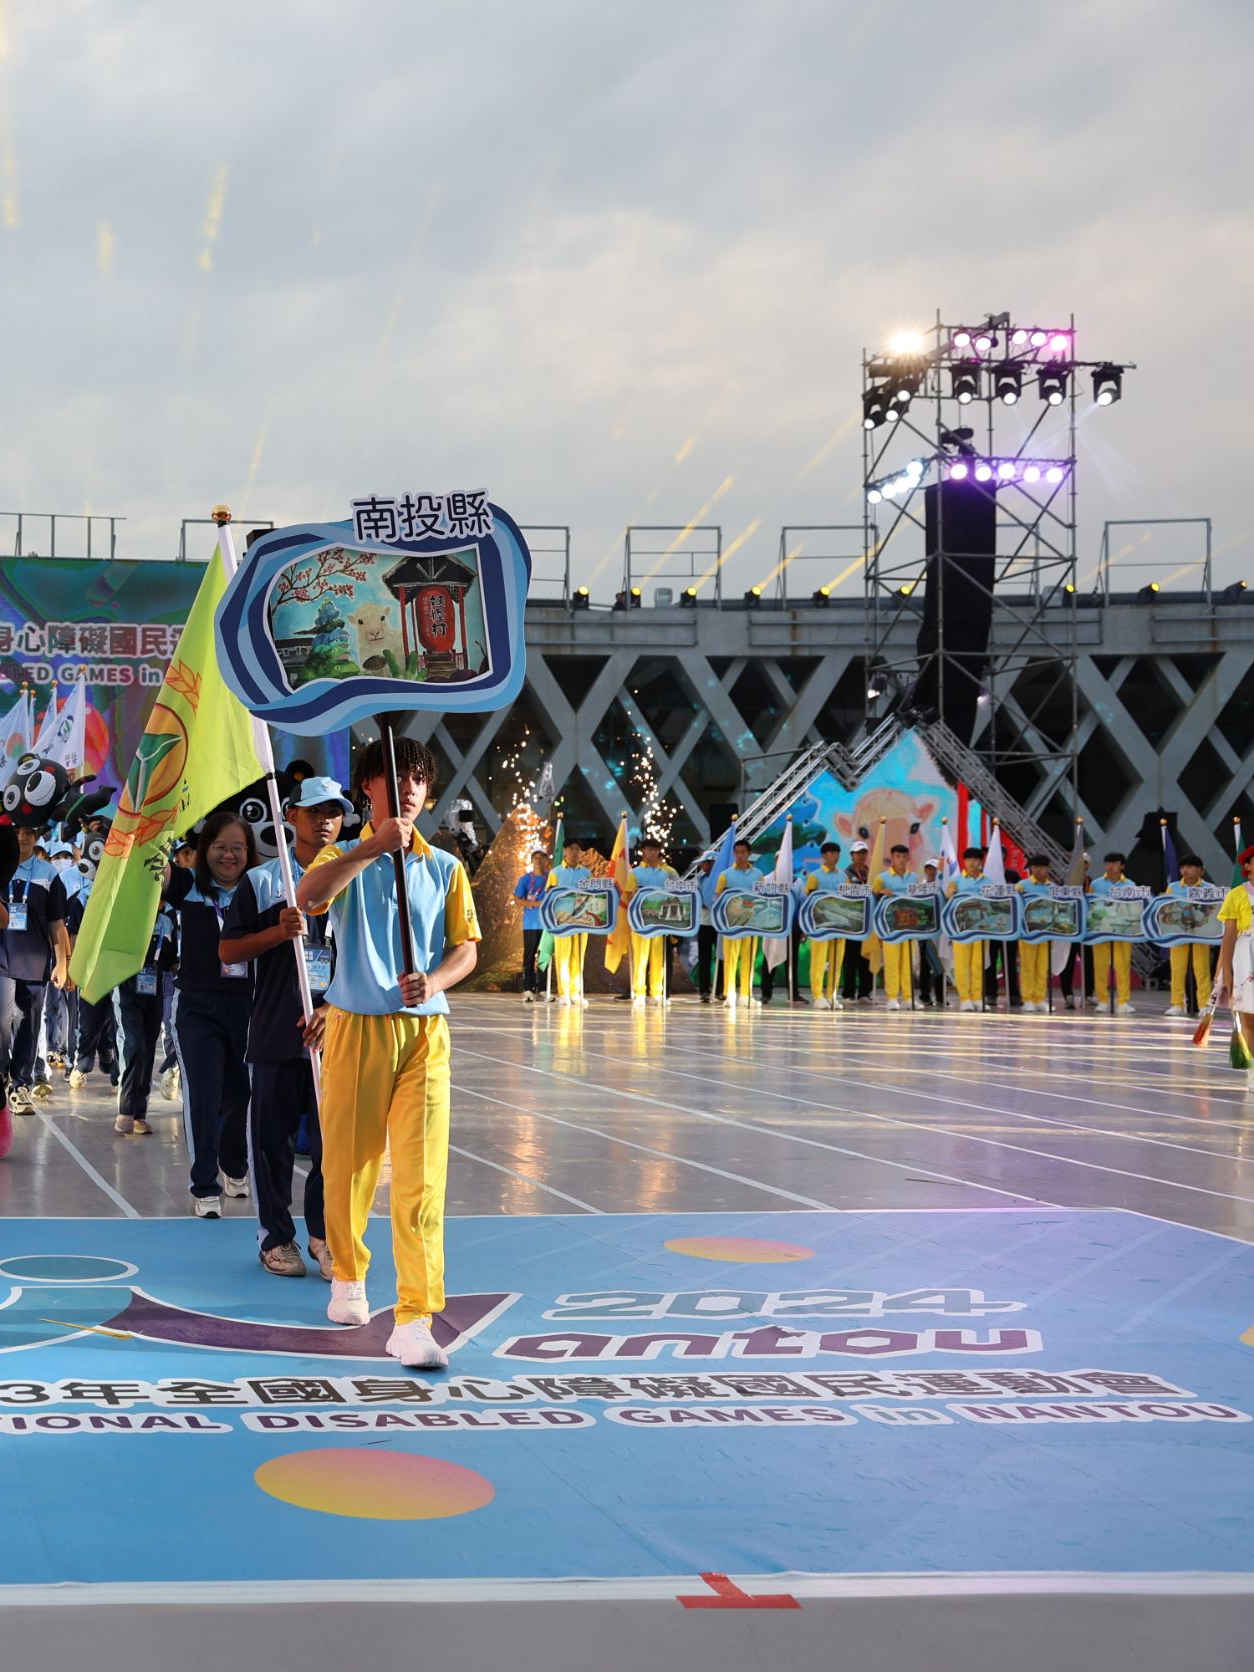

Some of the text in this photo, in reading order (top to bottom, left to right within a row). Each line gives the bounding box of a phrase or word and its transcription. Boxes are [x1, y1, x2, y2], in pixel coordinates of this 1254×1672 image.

[353, 491, 492, 541] 南投縣
[61, 665, 132, 682] GAMES
[141, 664, 161, 681] in
[579, 879, 613, 889] 金門縣
[666, 881, 697, 892] 台中市
[755, 882, 790, 893] 新竹縣
[552, 1291, 1019, 1315] 2024
[259, 1409, 583, 1429] DISABLED
[621, 1407, 849, 1425] GAMES
[873, 1405, 945, 1423] in
[967, 1403, 1241, 1422] NANTOU
